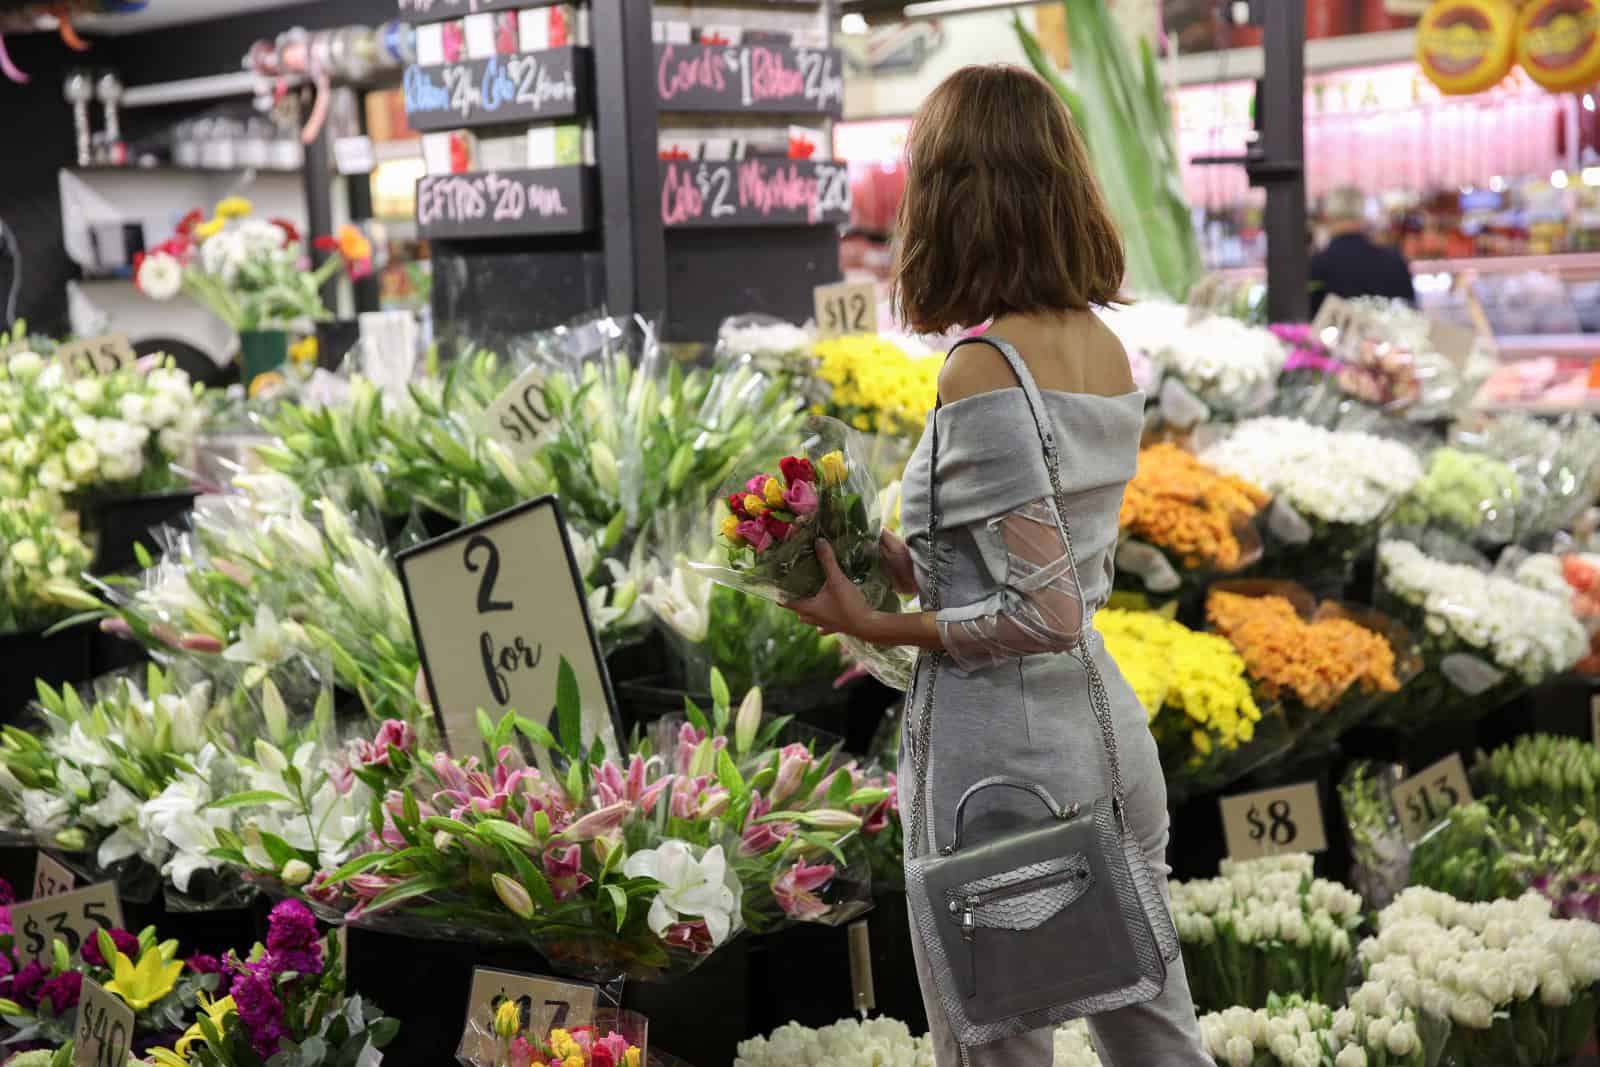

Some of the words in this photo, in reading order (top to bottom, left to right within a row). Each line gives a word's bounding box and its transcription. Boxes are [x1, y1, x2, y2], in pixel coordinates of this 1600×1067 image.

[696, 163, 736, 217] $2
[824, 293, 868, 334] $12
[499, 384, 552, 443] $10
[463, 535, 514, 613] 2
[480, 631, 542, 706] for
[1246, 799, 1297, 847] $8
[1405, 776, 1458, 826] $13
[24, 903, 112, 959] $35
[80, 997, 126, 1067] $40
